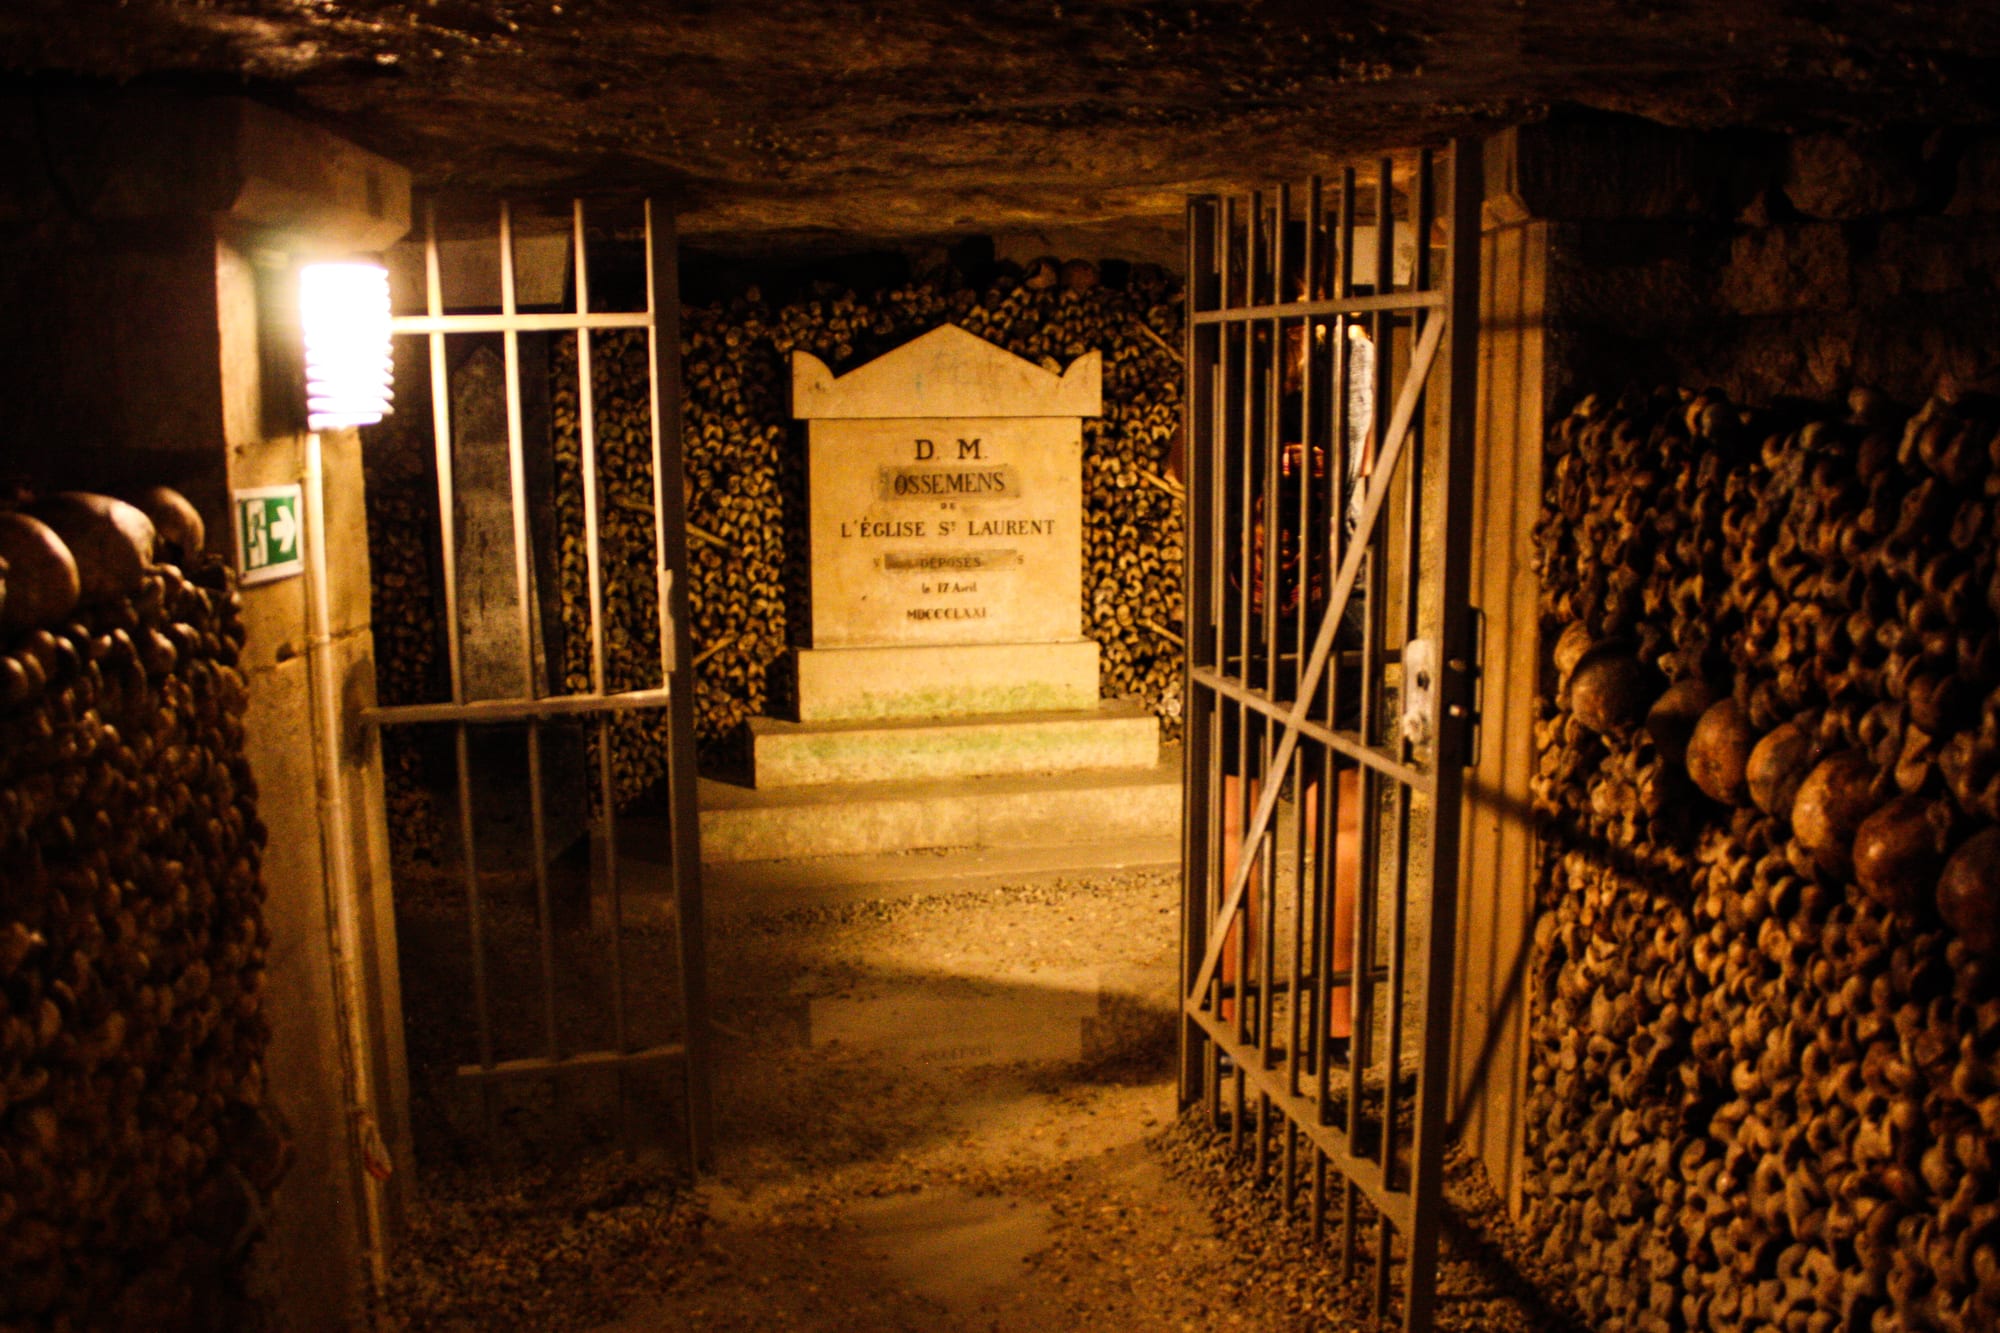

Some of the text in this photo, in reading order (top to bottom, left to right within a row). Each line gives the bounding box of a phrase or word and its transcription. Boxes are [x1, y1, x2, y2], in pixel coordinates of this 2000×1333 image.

[894, 472, 1006, 496] OSSEMENS
[968, 519, 1056, 537] LAURENT
[937, 581, 950, 593] 17
